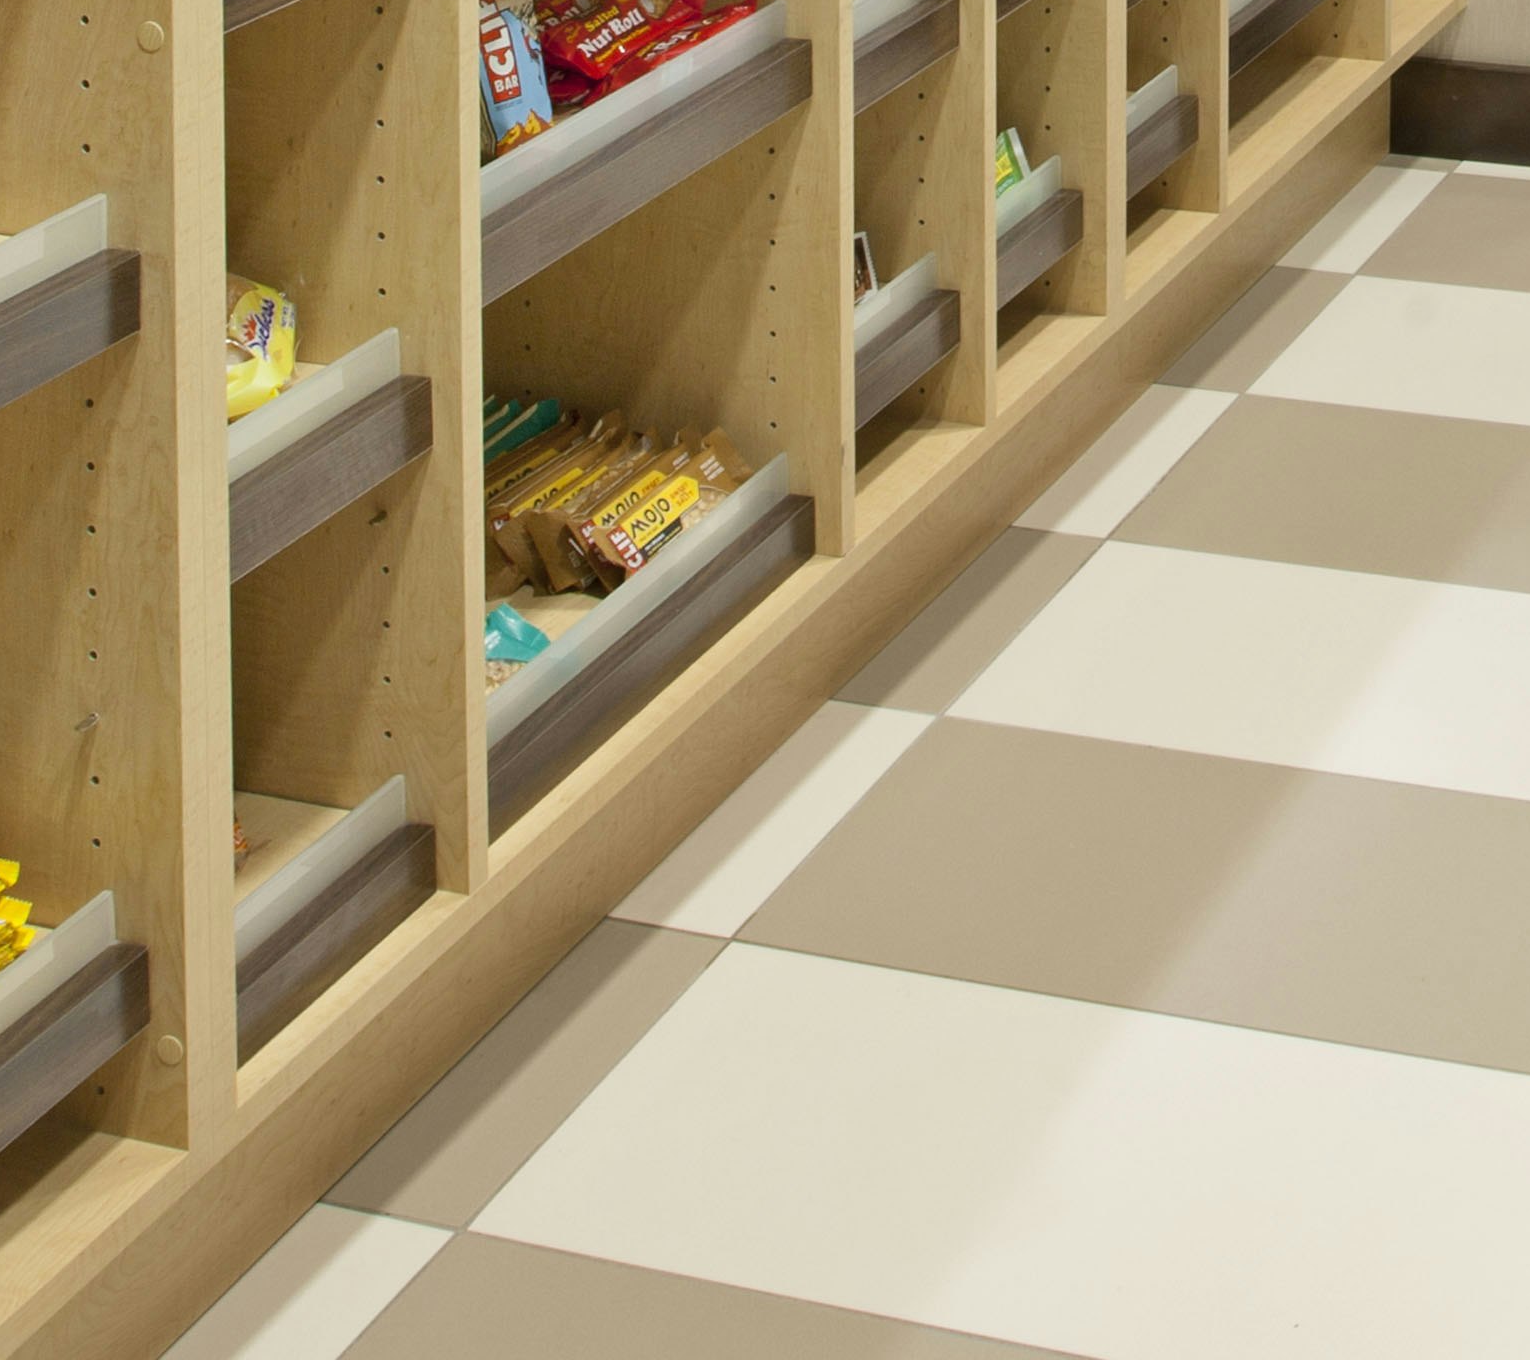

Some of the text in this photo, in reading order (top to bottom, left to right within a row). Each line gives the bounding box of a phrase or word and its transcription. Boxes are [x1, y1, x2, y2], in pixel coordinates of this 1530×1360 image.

[584, 6, 620, 32] Salted
[577, 8, 646, 58] Nut Roll
[493, 76, 519, 94] BAR
